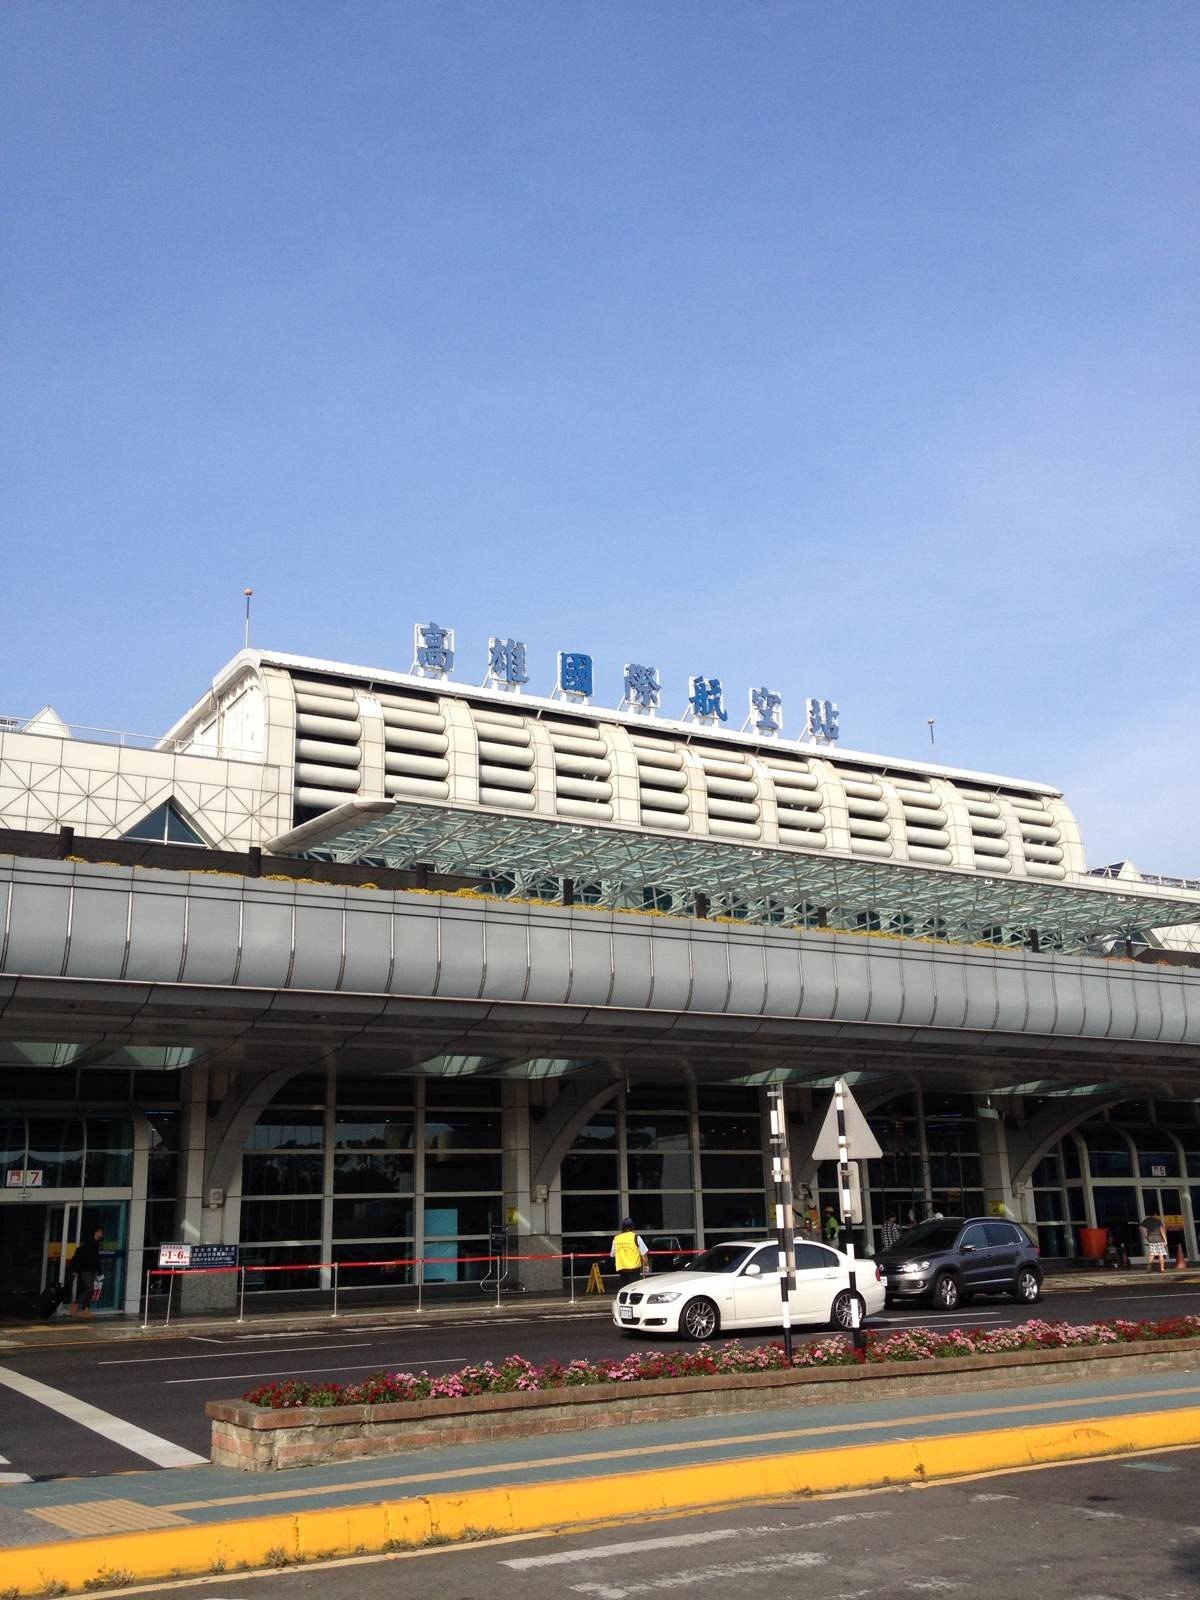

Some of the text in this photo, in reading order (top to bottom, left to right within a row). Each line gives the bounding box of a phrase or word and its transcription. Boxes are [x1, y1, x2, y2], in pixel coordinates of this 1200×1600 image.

[417, 622, 840, 740] 高雄國際航空站
[31, 1171, 40, 1185] 7
